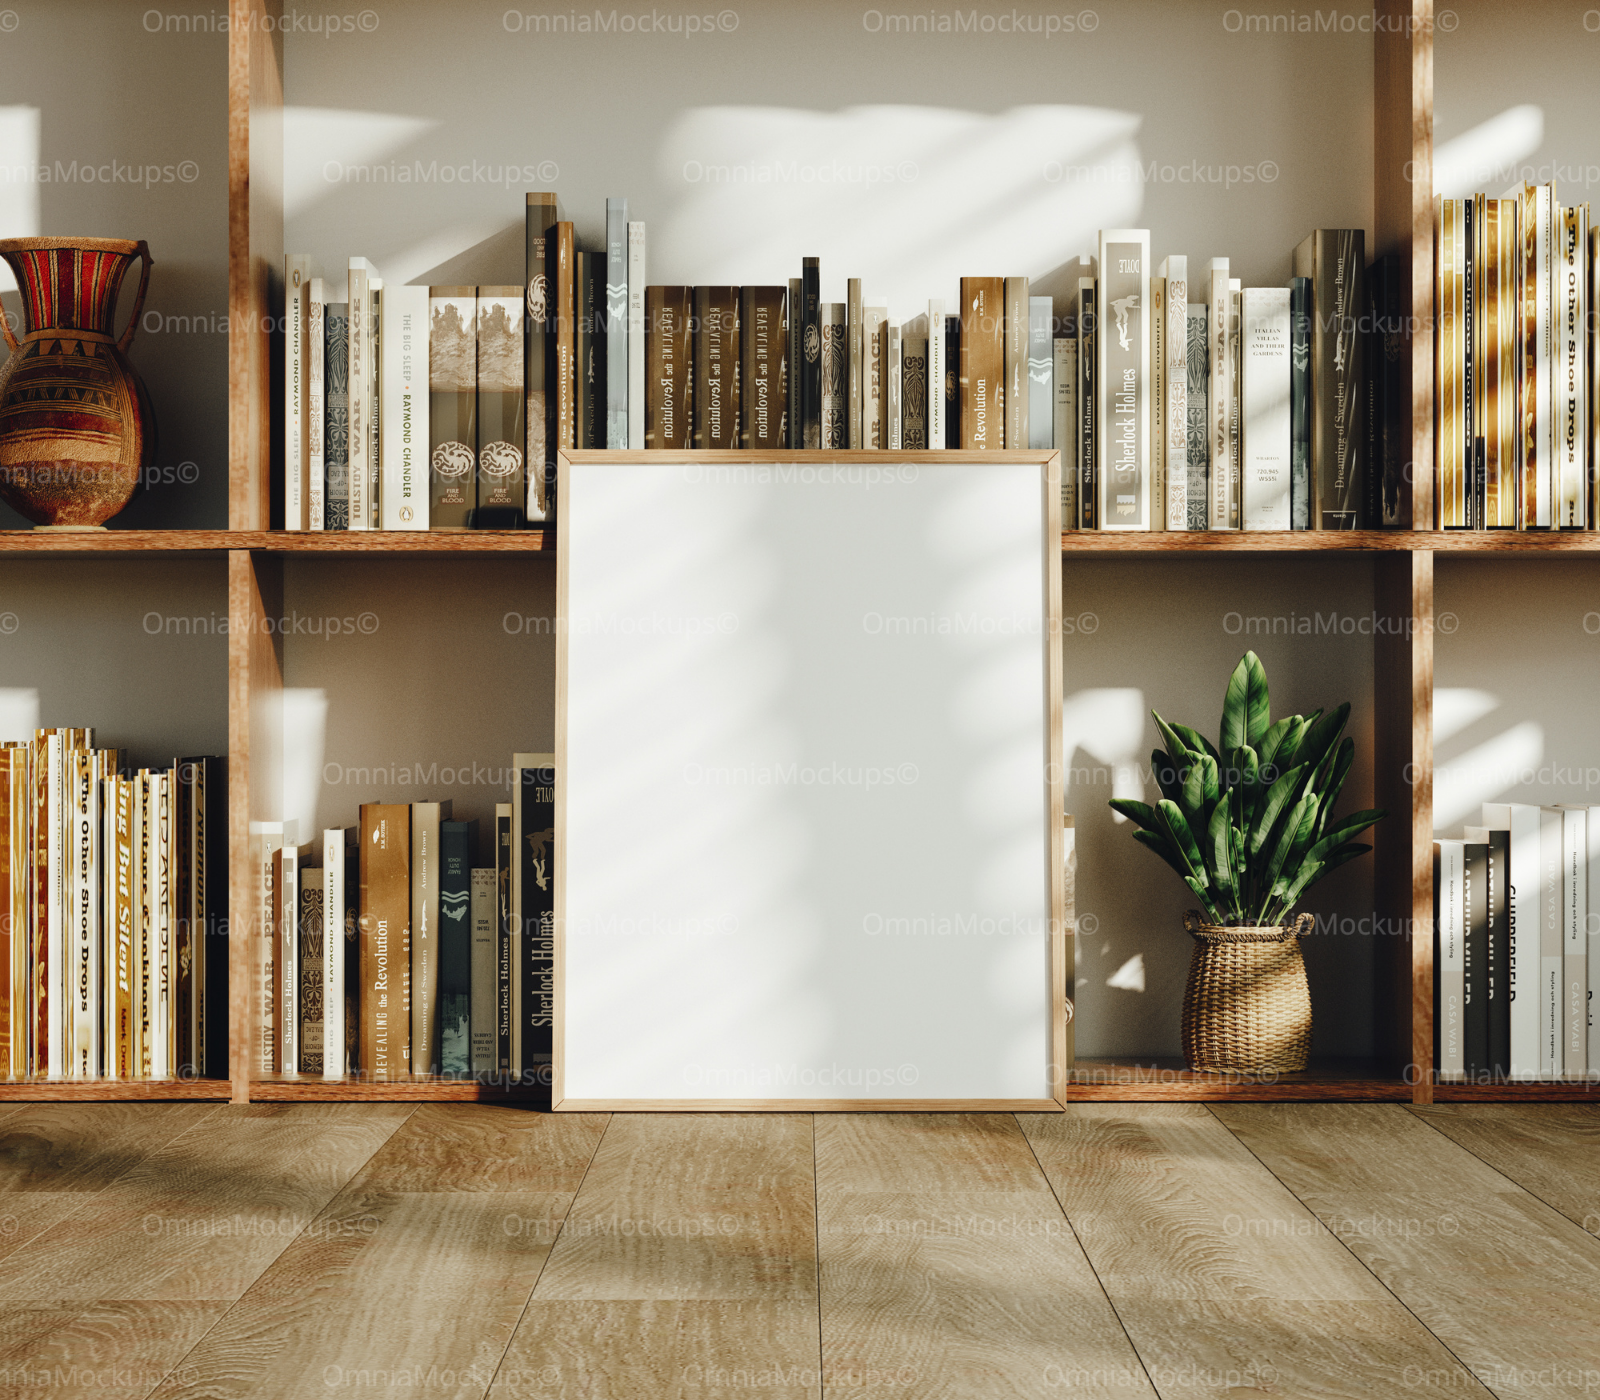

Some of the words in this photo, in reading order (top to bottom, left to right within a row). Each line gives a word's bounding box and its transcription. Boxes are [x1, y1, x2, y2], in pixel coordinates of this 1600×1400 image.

[1118, 259, 1140, 273] DOYLE
[1335, 258, 1343, 284] Brown
[403, 314, 411, 332] THE
[1335, 288, 1343, 319] Andrew
[353, 298, 361, 376] PEACE
[403, 335, 411, 352] BIG
[1217, 298, 1225, 376] PEACE
[403, 355, 411, 382] SLEEP
[871, 332, 880, 400] PEACE
[1115, 368, 1136, 414] Holmes
[353, 399, 361, 456] WAR
[403, 394, 411, 444] RAYMOND
[974, 378, 986, 442] Revolution
[1217, 399, 1225, 458] WAR
[1334, 382, 1344, 423] Sweden
[1334, 423, 1344, 435] of
[1115, 417, 1136, 472] Sherlock
[1566, 397, 1576, 464] Drops
[403, 447, 411, 498] CHANDLER
[1334, 437, 1346, 488] Dreaming
[353, 465, 361, 520] TOLSTOY
[1217, 466, 1225, 520] TOLSTOY
[119, 841, 130, 898] But
[264, 862, 274, 938] PEACE
[119, 903, 130, 994] Silent
[374, 920, 388, 991] Revolution
[501, 937, 509, 980] Holmes
[531, 910, 554, 961] Holmes
[80, 946, 89, 1012] Drops
[264, 960, 274, 1018] WAR
[378, 994, 388, 1007] the
[421, 989, 427, 1000] of
[531, 966, 554, 1027] Sherlock
[501, 984, 509, 1036] Sherlock
[376, 1011, 388, 1074] REVEALING
